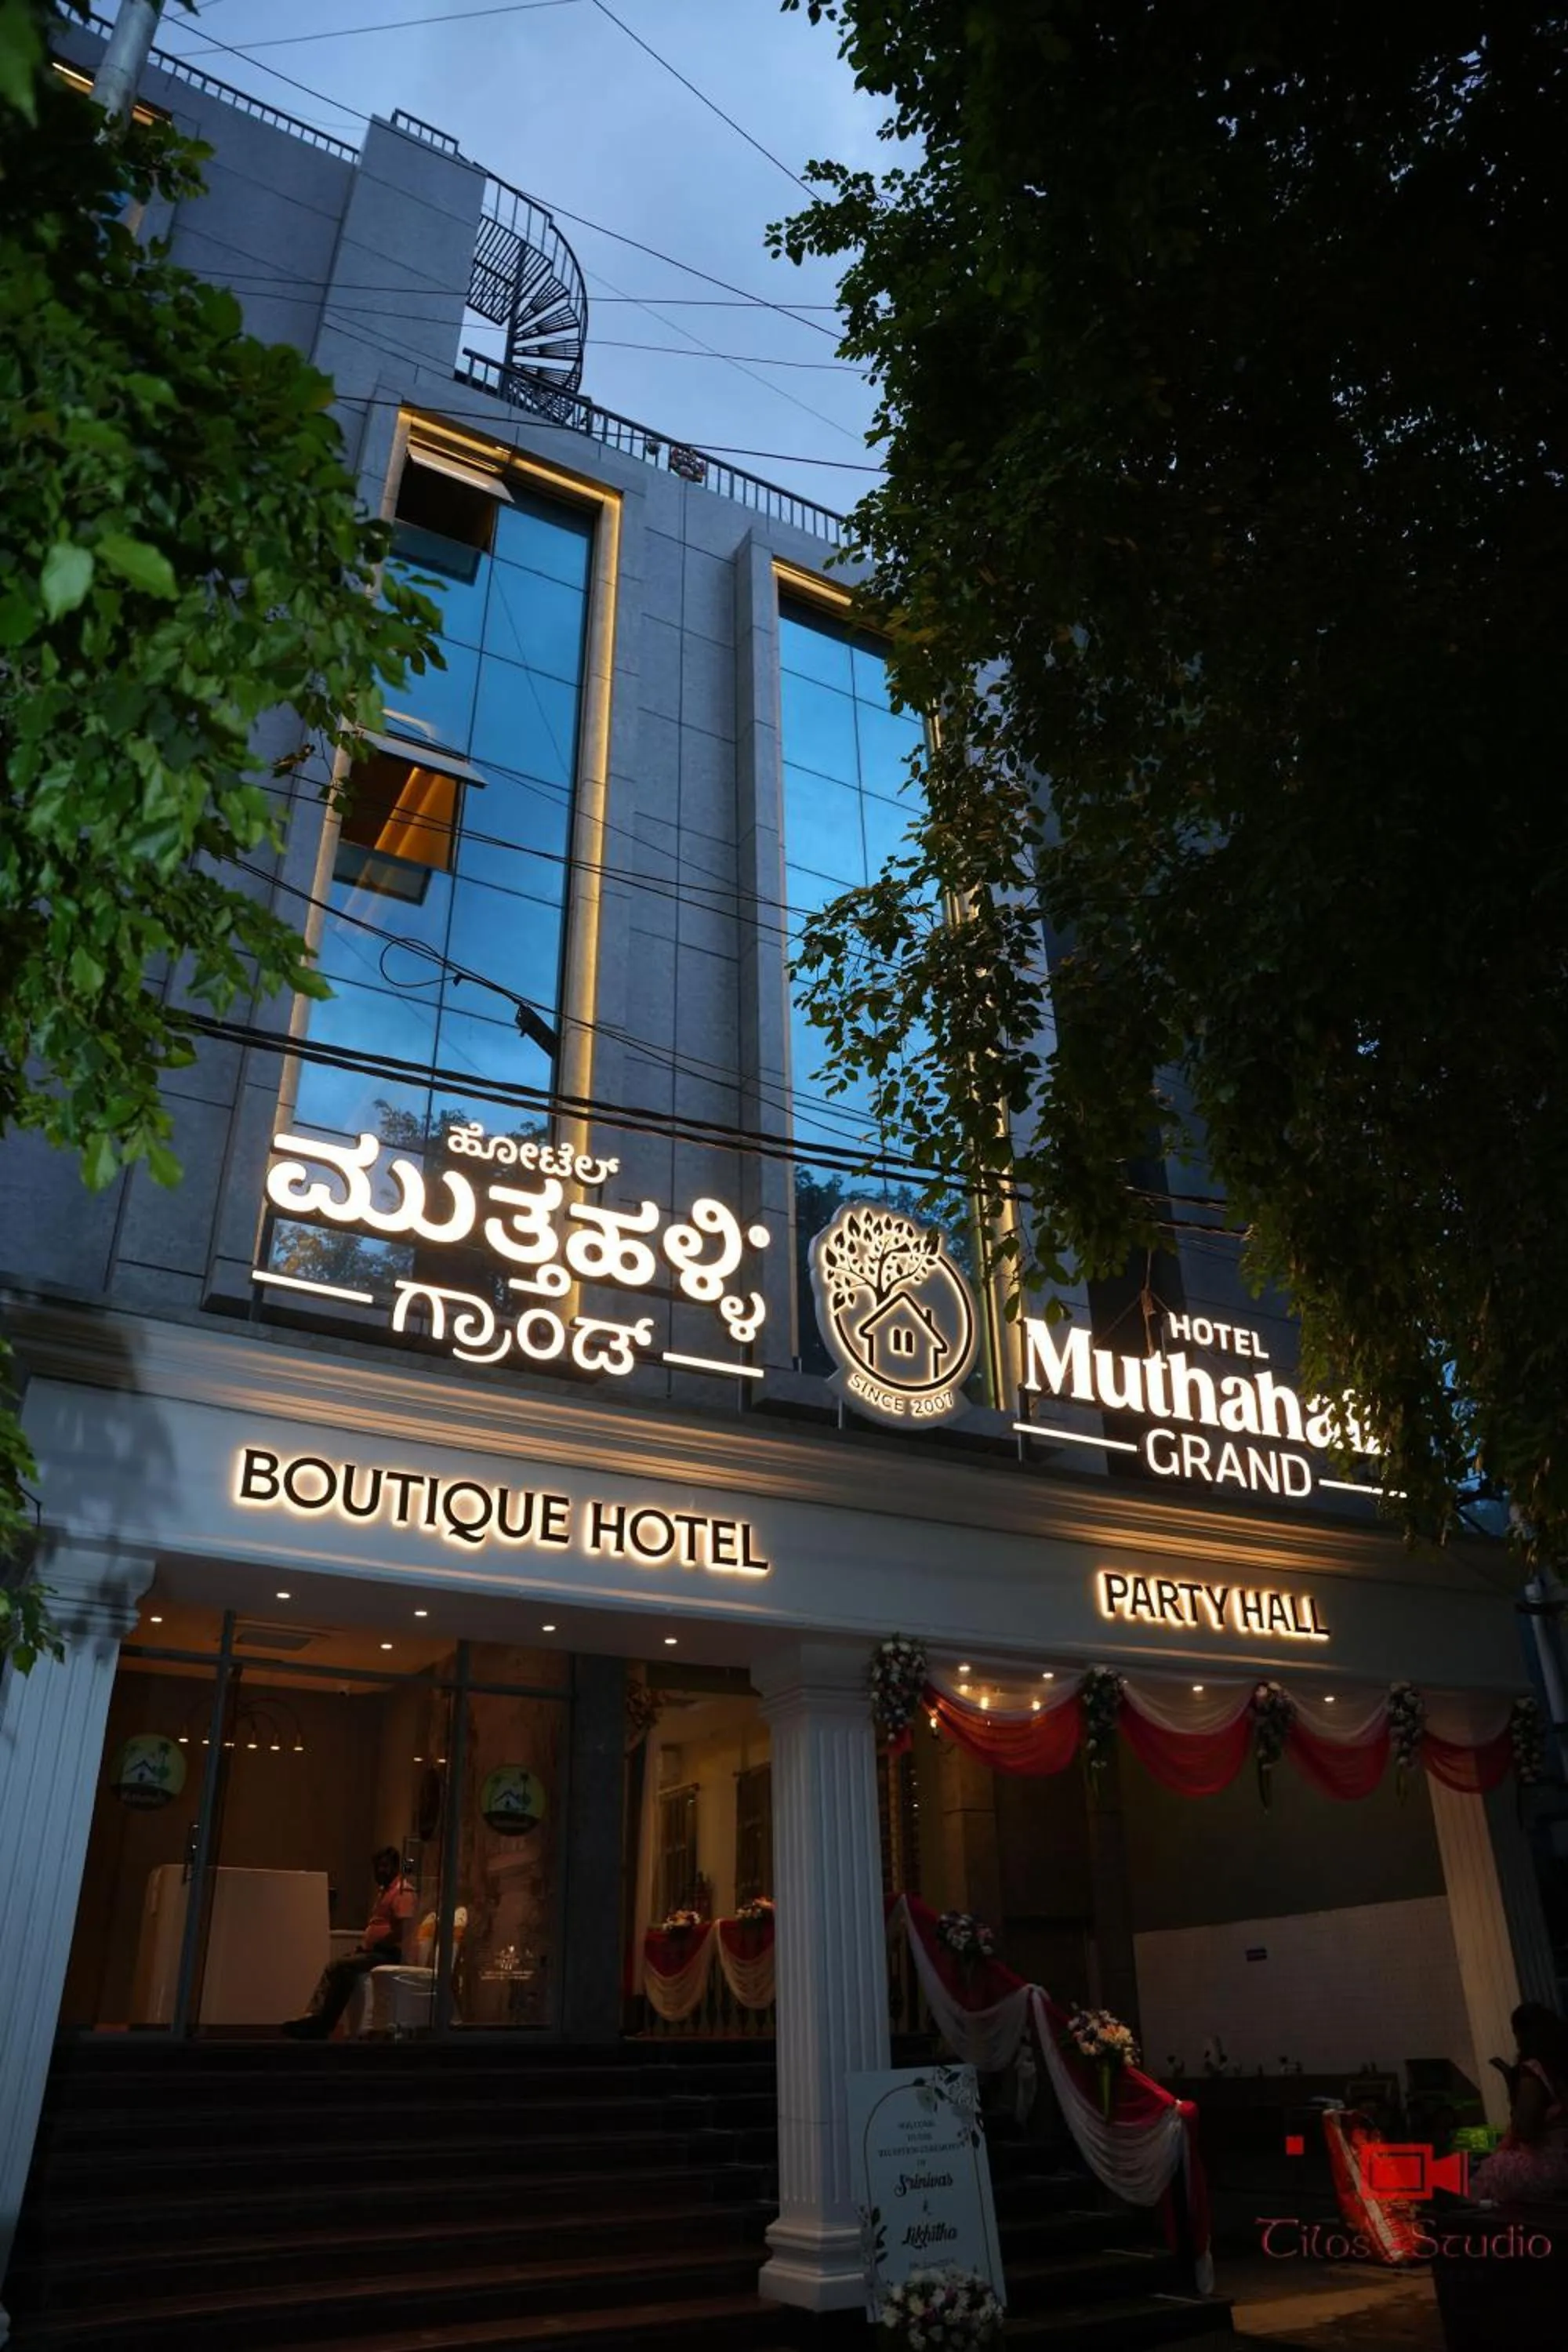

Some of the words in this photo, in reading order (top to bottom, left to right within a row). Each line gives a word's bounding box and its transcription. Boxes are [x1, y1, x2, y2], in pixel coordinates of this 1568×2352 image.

[448, 1122, 619, 1184] ಹೋಟೆಲ್
[393, 1279, 654, 1377] ಗ್ರಾಂಡ್
[1168, 1312, 1269, 1359] HOTEL
[849, 1374, 905, 1412] SINCE
[1146, 1428, 1312, 1497] GRAND
[239, 1449, 571, 1544] BOUTIQUE
[591, 1501, 769, 1571] HOTEL
[1102, 1573, 1229, 1628] PARTY
[1237, 1588, 1331, 1639] HALL
[894, 2172, 953, 2198] Srinivas
